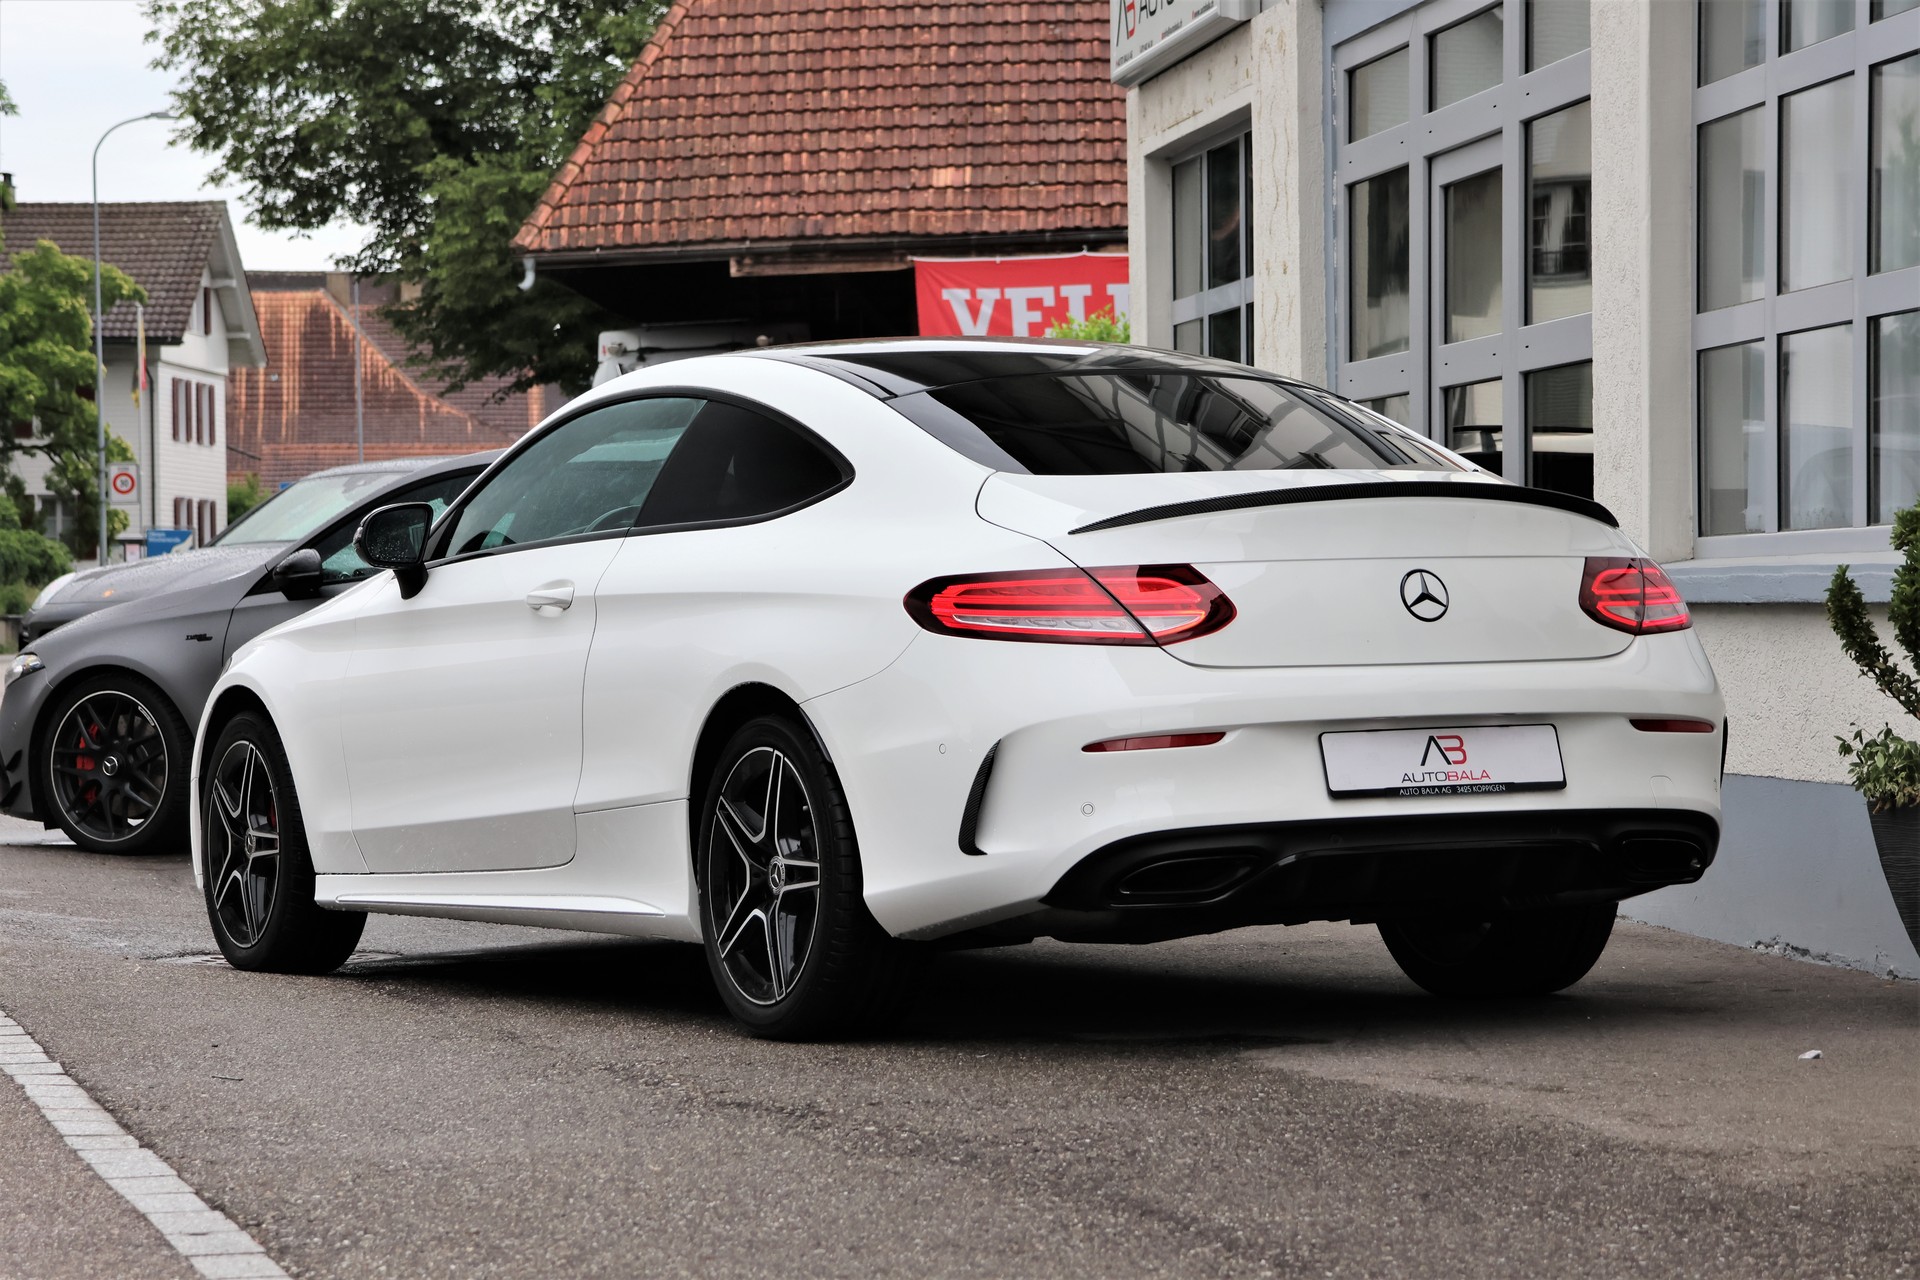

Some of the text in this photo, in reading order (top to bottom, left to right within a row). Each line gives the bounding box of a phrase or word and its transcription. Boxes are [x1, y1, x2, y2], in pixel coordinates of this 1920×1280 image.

[1420, 735, 1467, 766] AB
[1401, 769, 1491, 783] AUTOBALA
[1400, 784, 1506, 796] AUTO BALA AG 3425 KOPPIGEN
